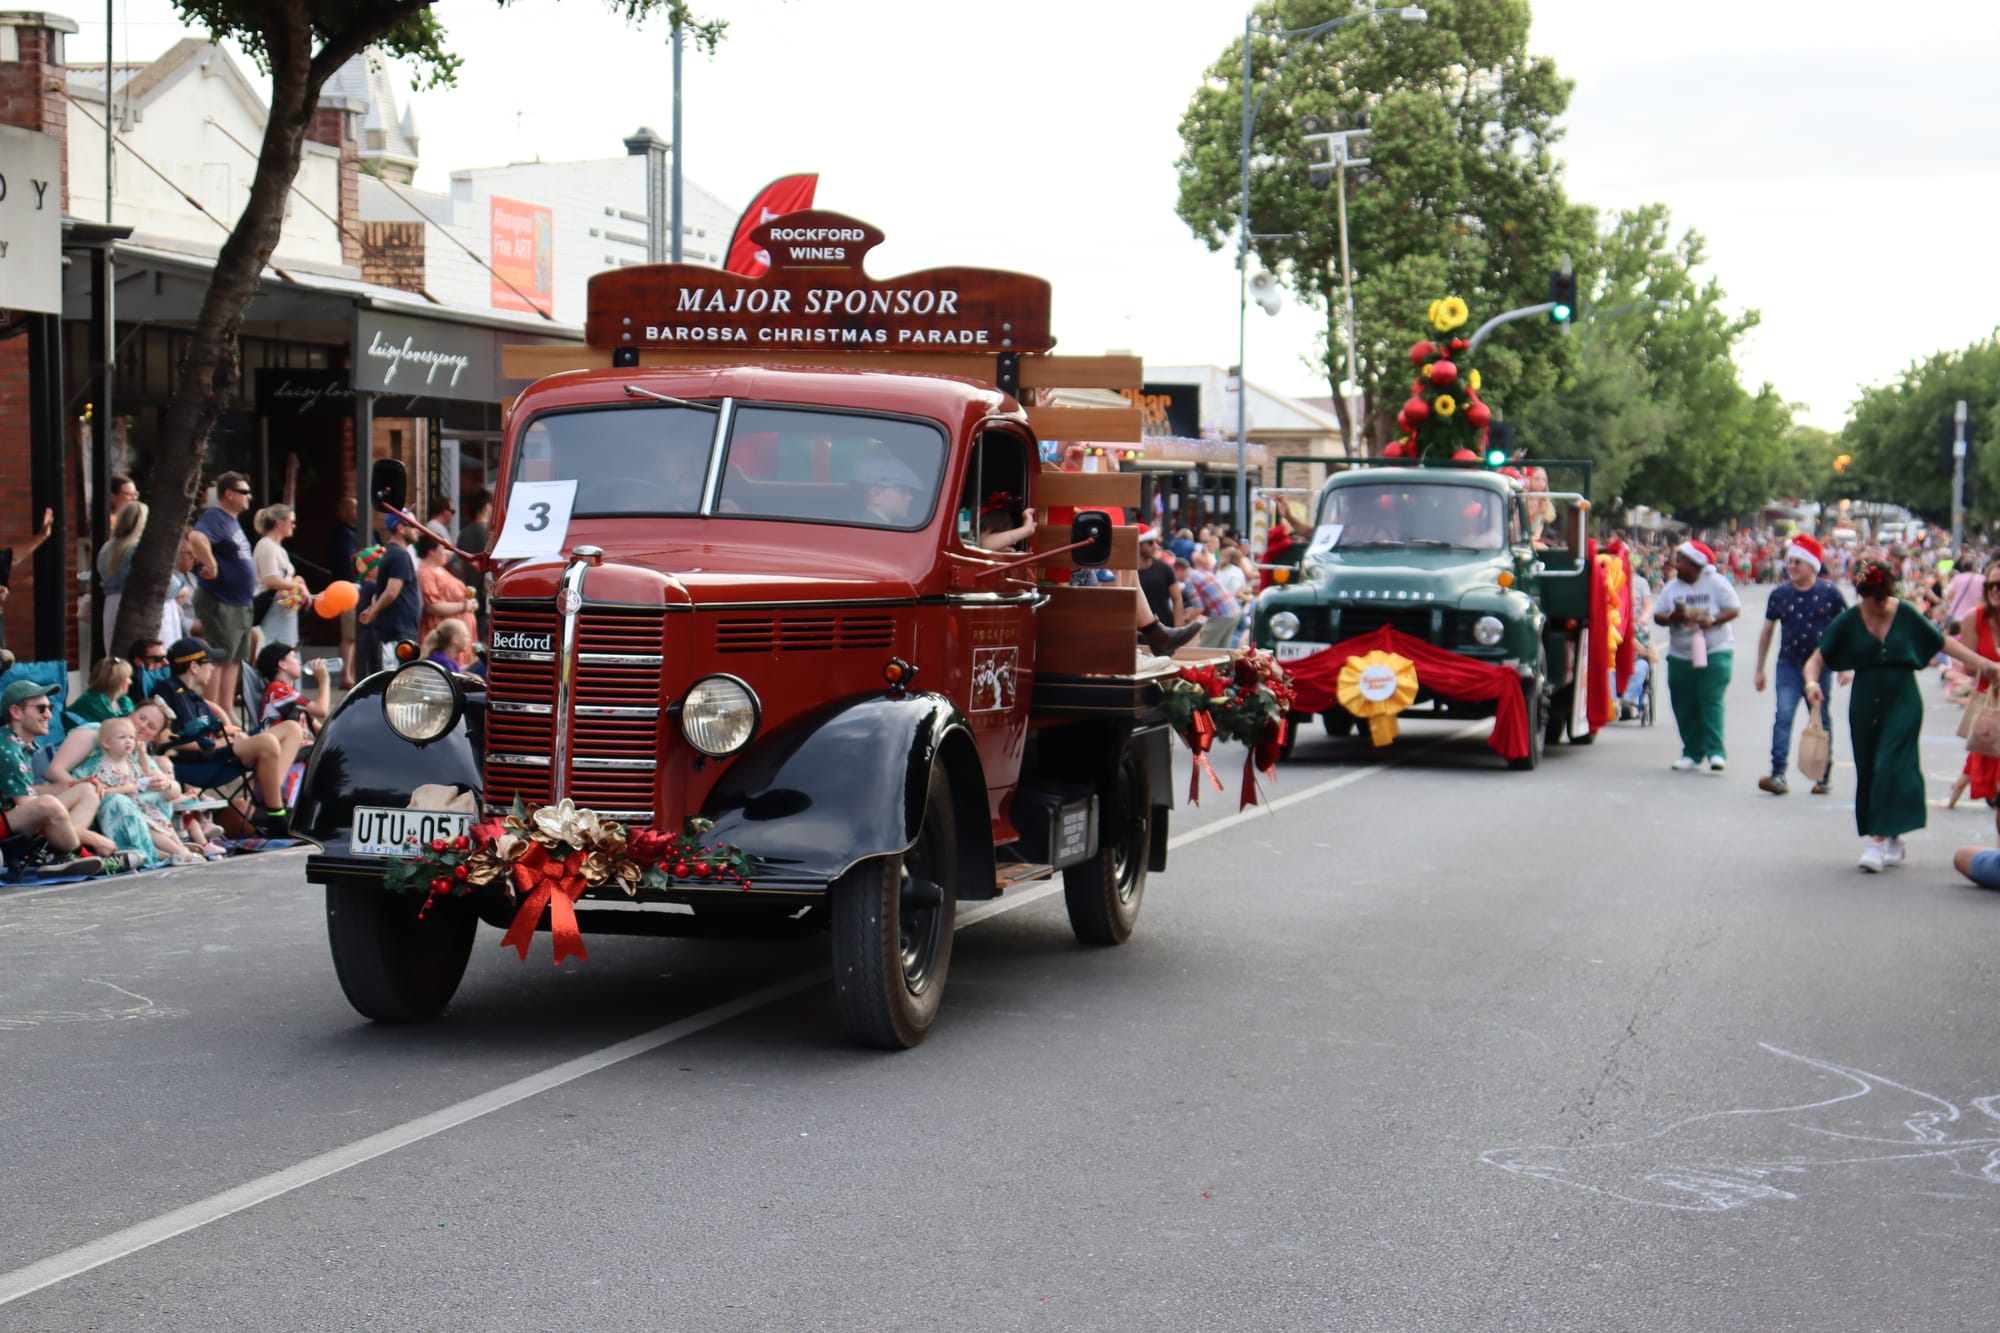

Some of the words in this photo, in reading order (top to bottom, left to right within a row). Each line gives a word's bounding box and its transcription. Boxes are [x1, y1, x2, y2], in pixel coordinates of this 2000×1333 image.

[770, 228, 865, 241] ROCKFORD
[514, 237, 532, 261] ART
[790, 247, 845, 260] WINES
[676, 288, 792, 313] MAJOR
[804, 289, 958, 315] SPONSOR
[645, 326, 748, 341] BAROSSA
[758, 327, 888, 343] CHRISTMAS
[898, 329, 989, 344] PARADE
[524, 502, 551, 532] 3
[1338, 590, 1436, 601] BEDFORD
[493, 631, 551, 650] Bedford
[358, 812, 405, 845] UTU
